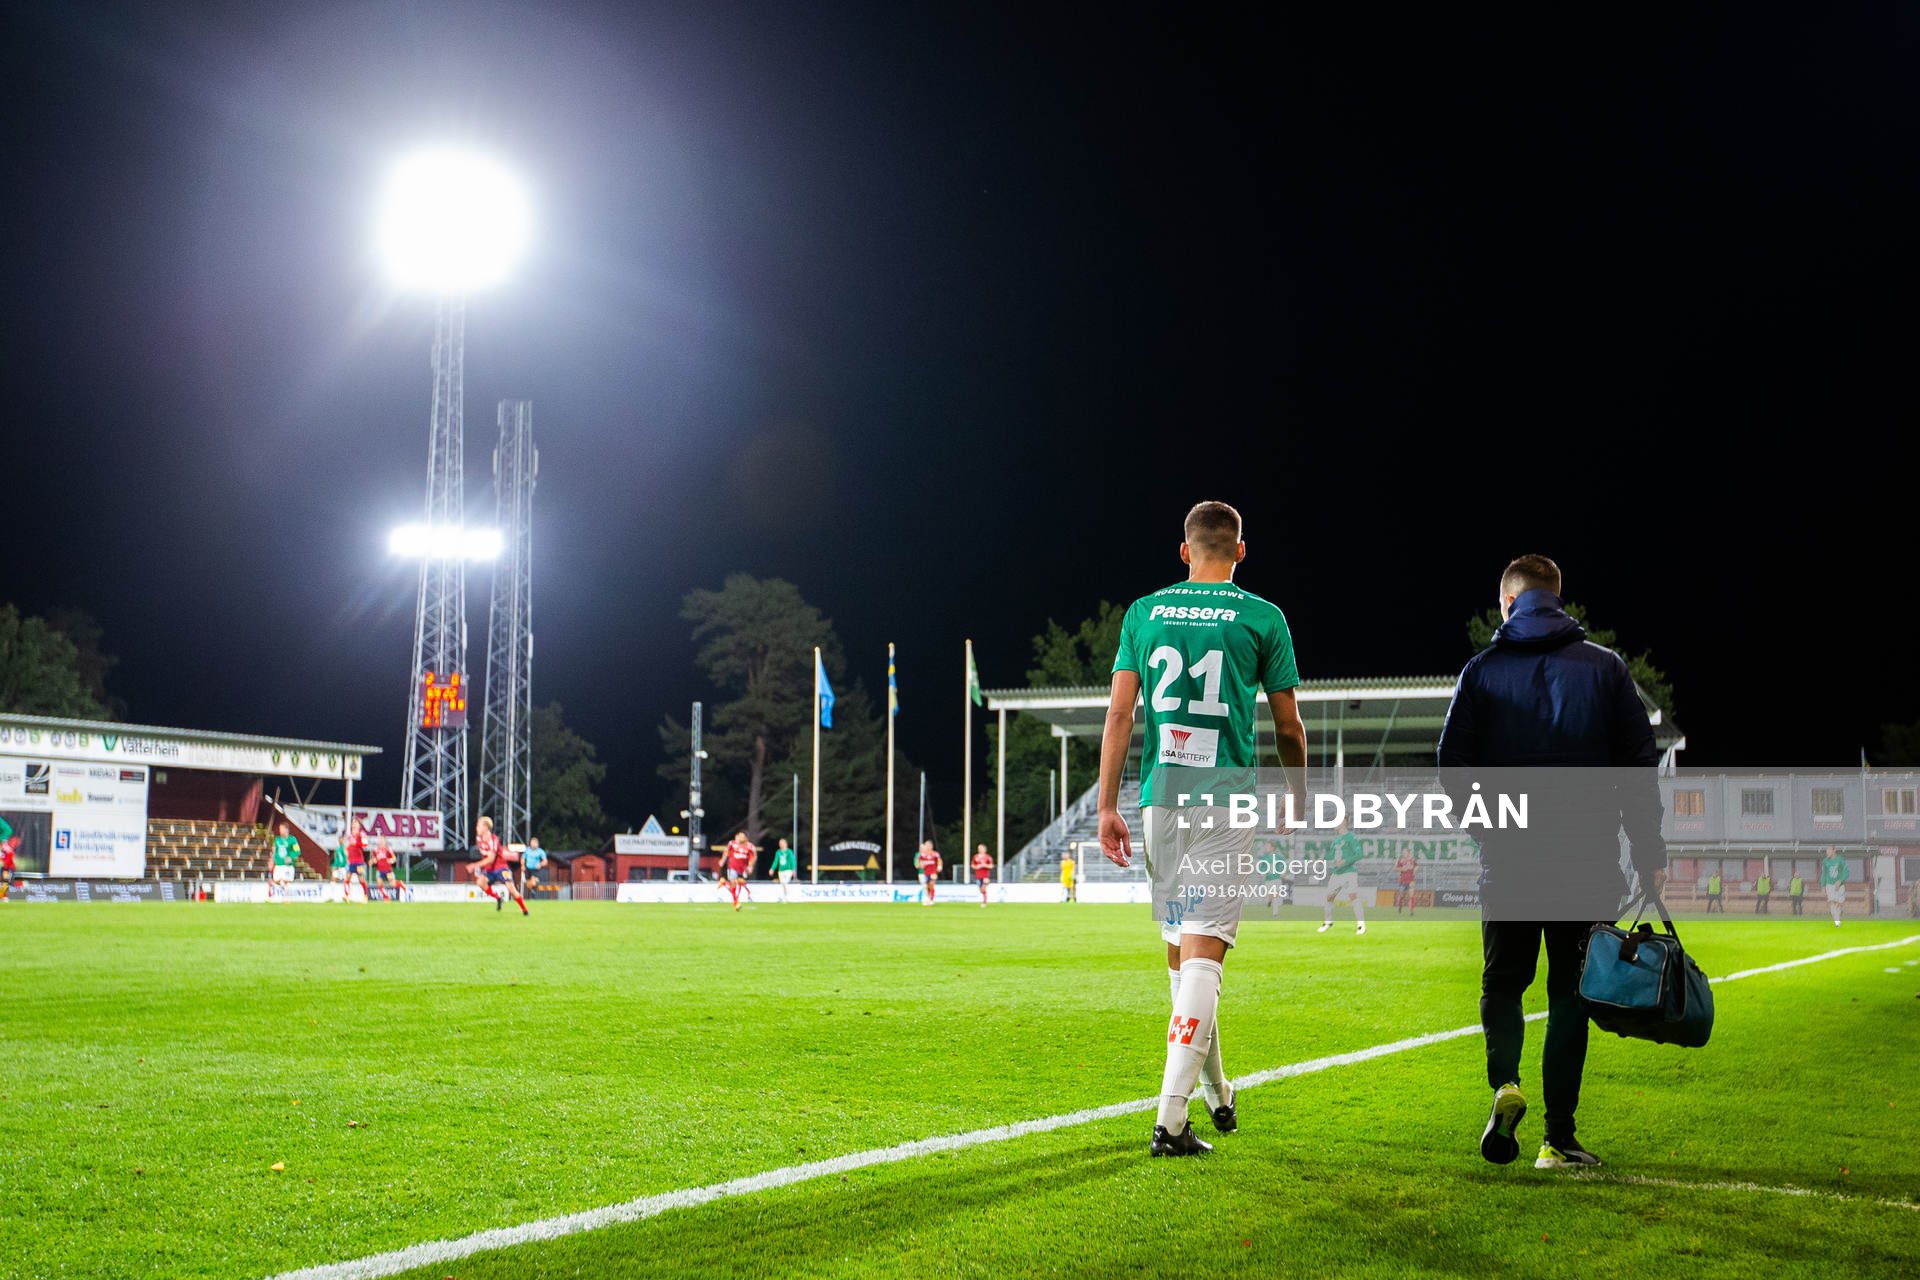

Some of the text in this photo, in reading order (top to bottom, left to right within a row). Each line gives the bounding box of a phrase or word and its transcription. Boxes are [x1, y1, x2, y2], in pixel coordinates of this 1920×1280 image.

[1149, 604, 1237, 622] Passera
[1148, 645, 1229, 717] 21
[1177, 752, 1211, 762] BATTERY
